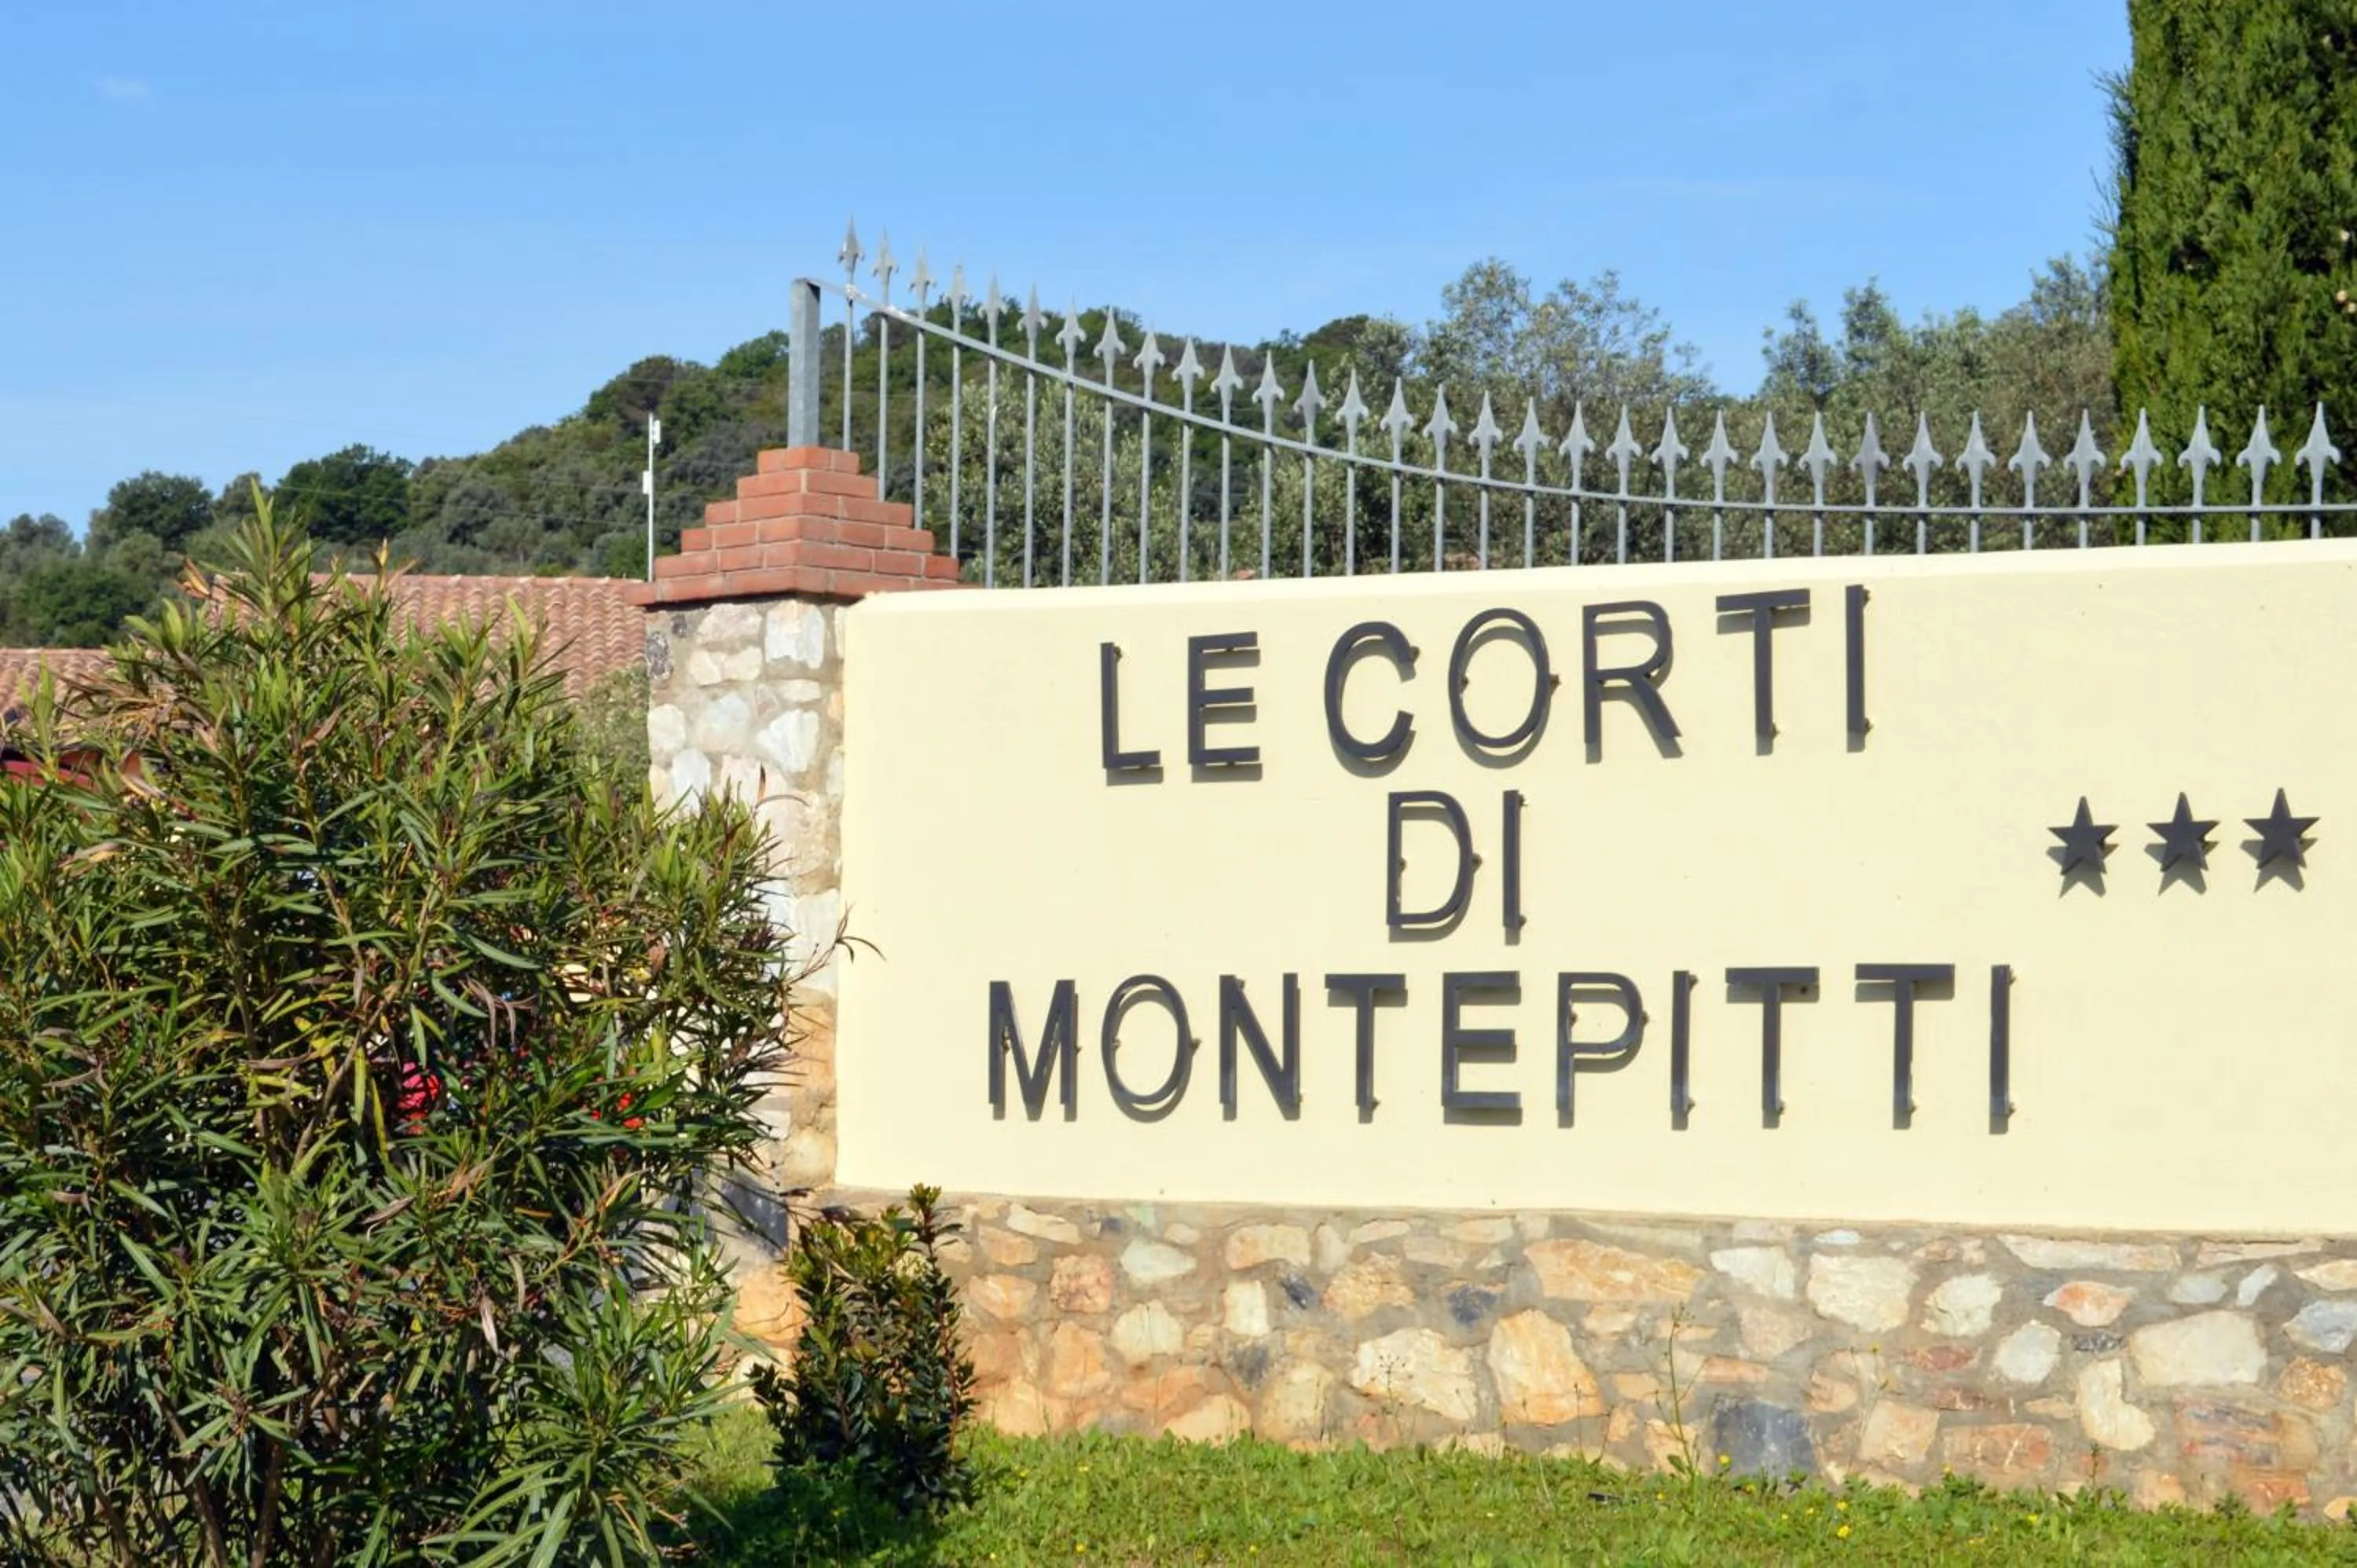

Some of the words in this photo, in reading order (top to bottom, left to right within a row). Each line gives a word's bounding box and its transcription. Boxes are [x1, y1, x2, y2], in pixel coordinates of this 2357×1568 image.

[1100, 631, 1260, 769] LE
[1324, 584, 1868, 762] CORTI
[1386, 789, 1523, 929] DI
[988, 963, 2011, 1119] MONTEPITTI
